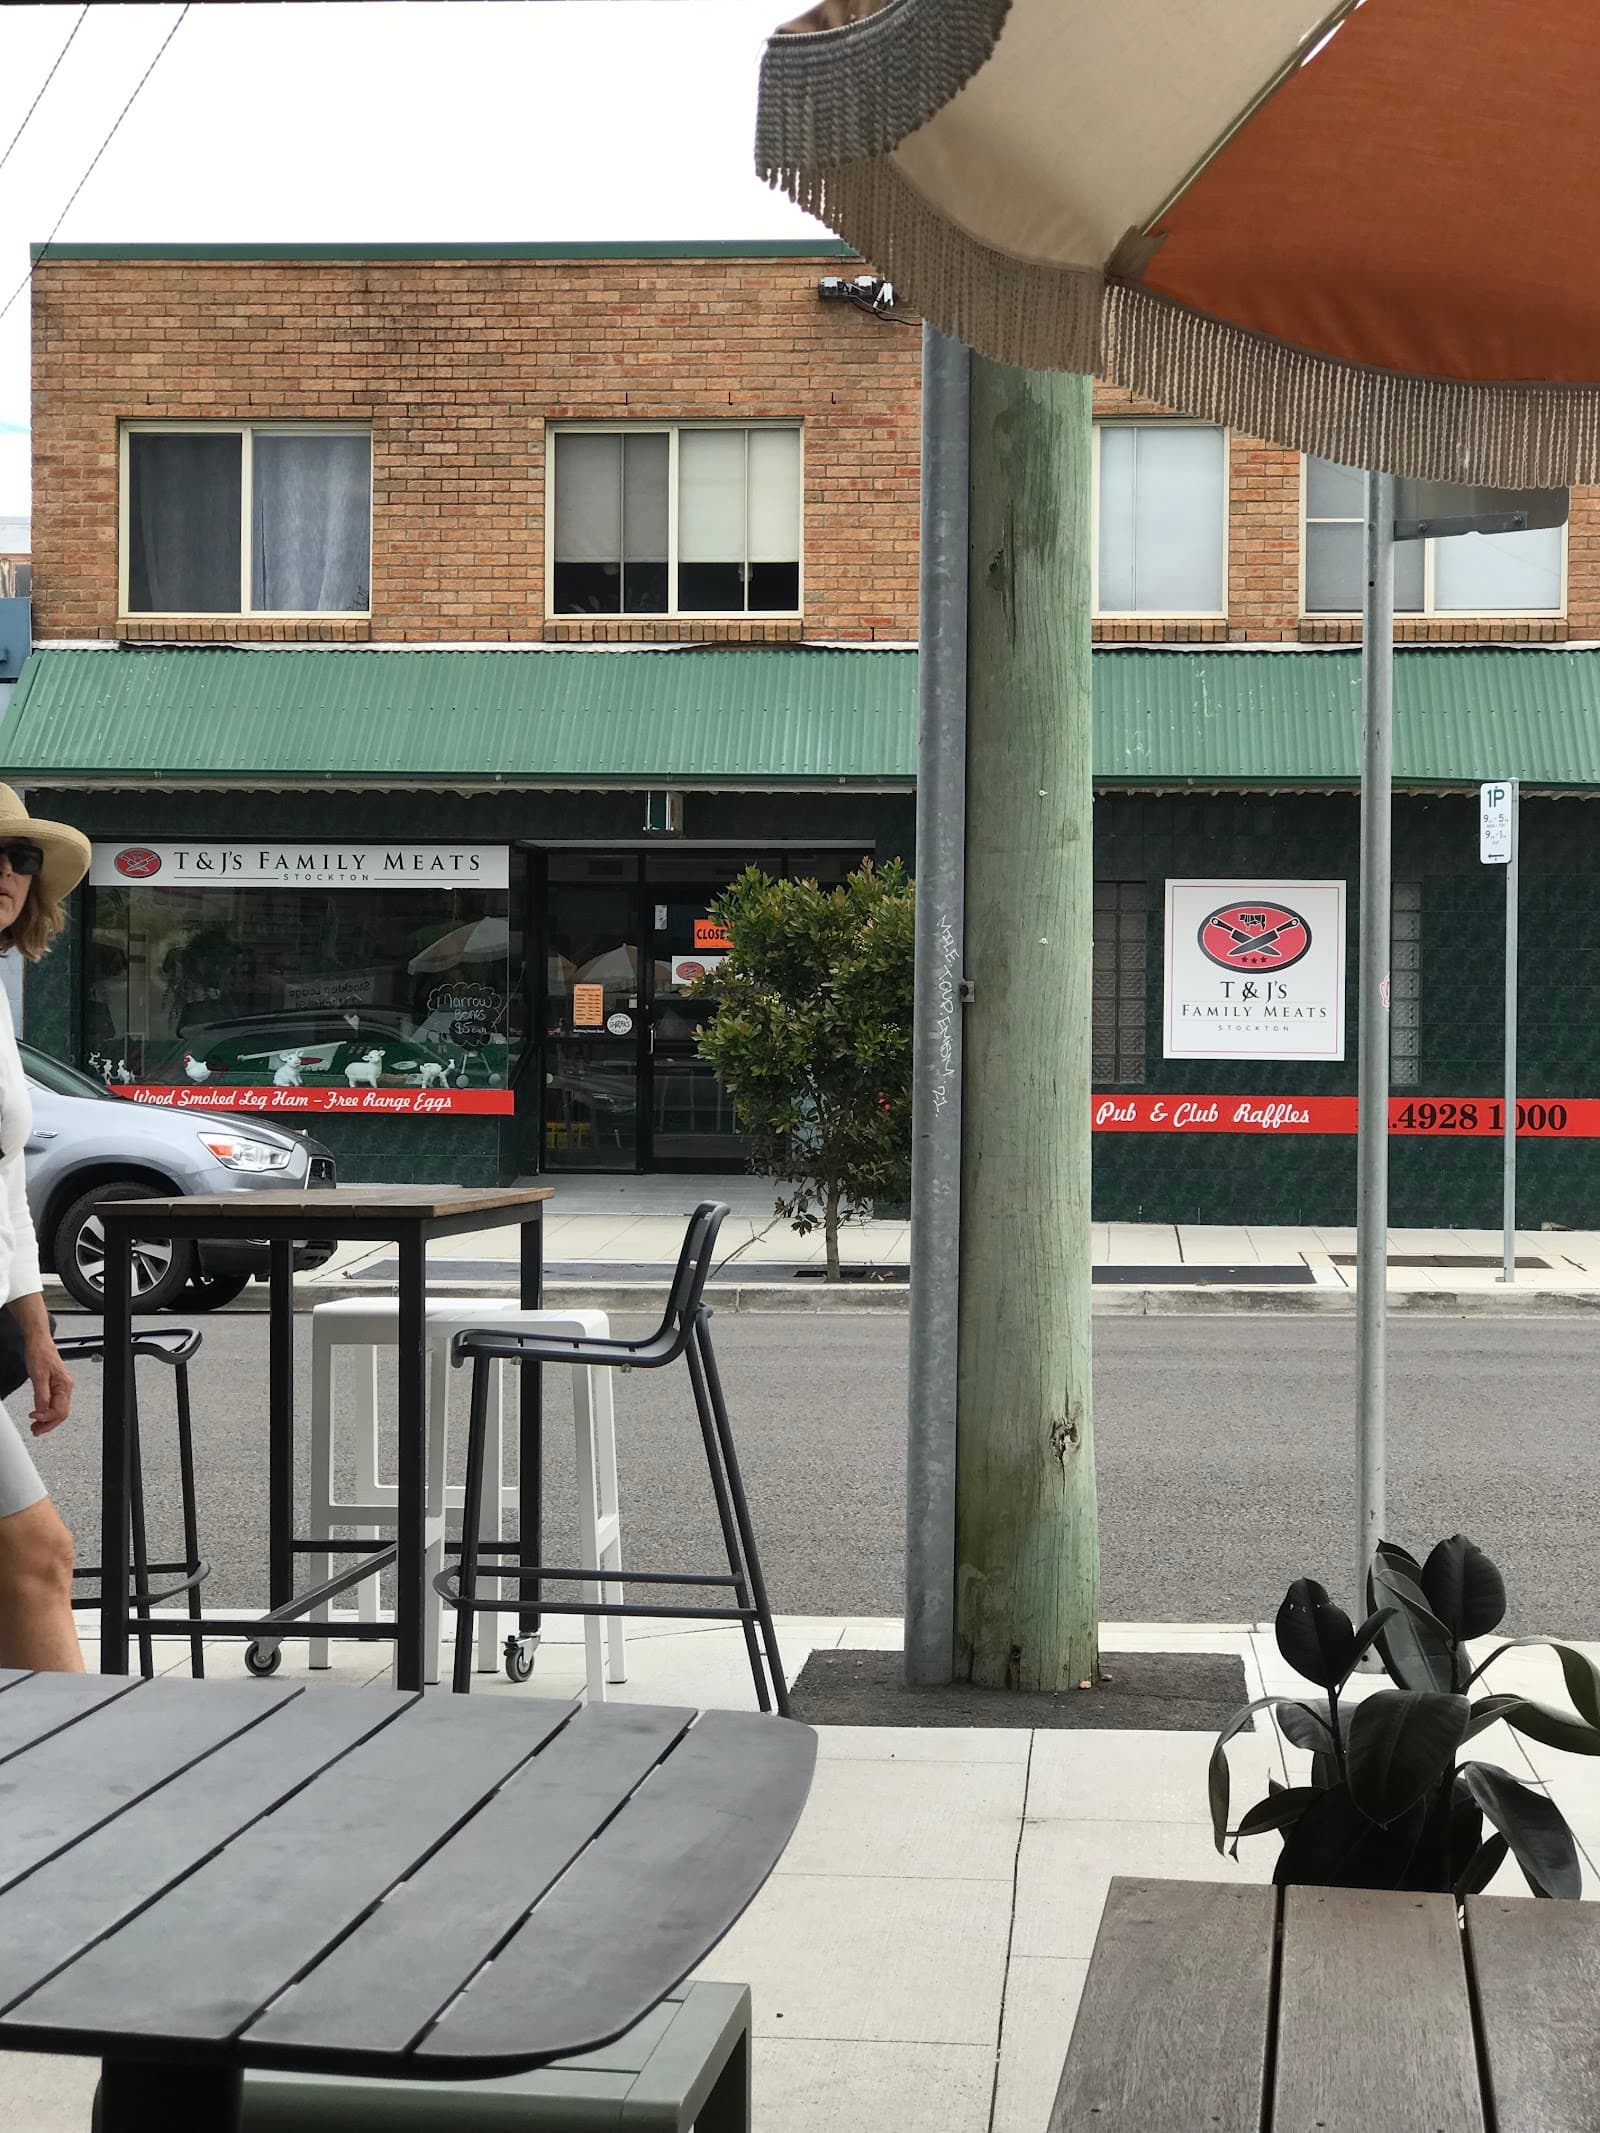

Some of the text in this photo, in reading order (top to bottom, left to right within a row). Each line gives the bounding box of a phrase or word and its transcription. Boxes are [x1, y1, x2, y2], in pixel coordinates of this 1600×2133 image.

[1487, 788, 1505, 808] 1P
[258, 851, 367, 871] FAMILY
[383, 851, 481, 871] MEATS
[283, 873, 369, 881] STOCKTON
[696, 928, 729, 940] CLOSE
[437, 992, 493, 1009] Marrow
[1182, 1004, 1327, 1018] FAMILY MEATS
[1218, 1024, 1289, 1032] STOCKTON
[133, 1089, 176, 1105] Wood
[177, 1089, 238, 1107] Smoked
[239, 1090, 268, 1110] Leg
[271, 1090, 308, 1106] Ham
[324, 1091, 359, 1110] Free
[363, 1092, 410, 1111] Range
[413, 1092, 452, 1112] Eggs
[1096, 1101, 1310, 1129] Pub & Club Raffles
